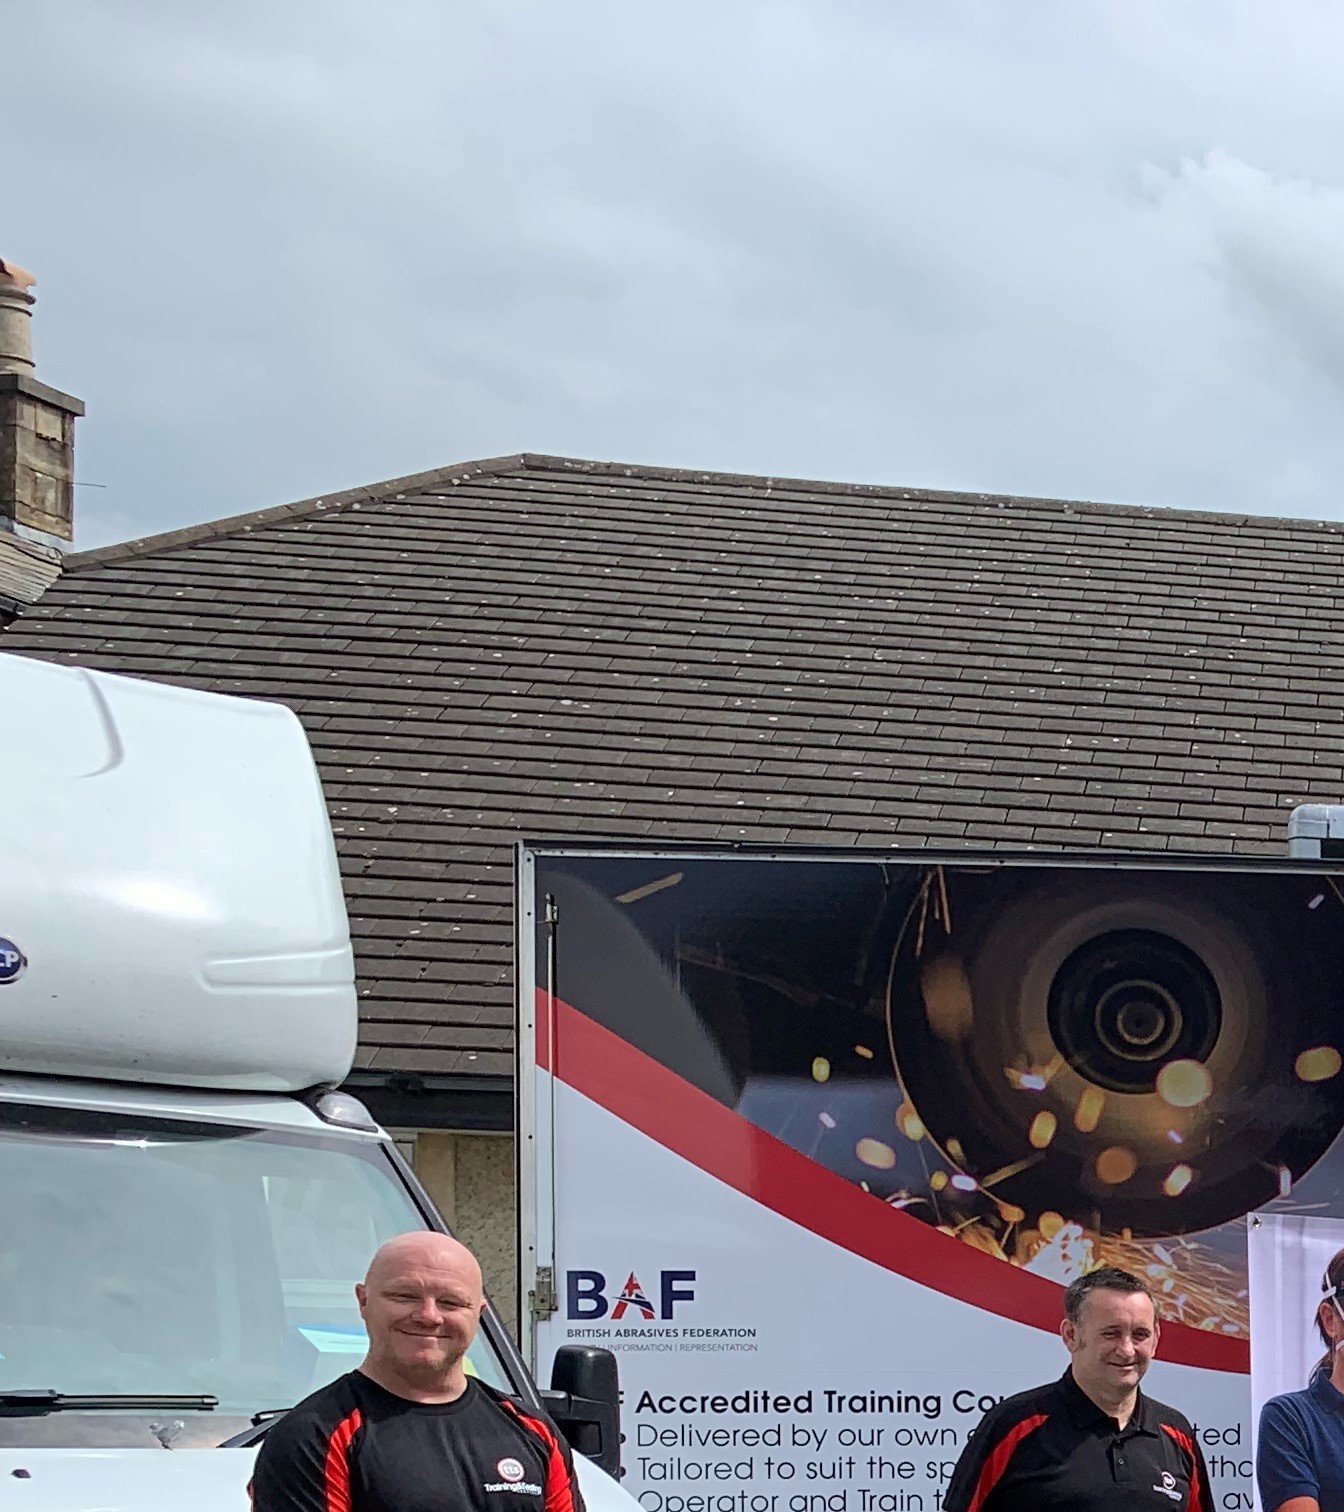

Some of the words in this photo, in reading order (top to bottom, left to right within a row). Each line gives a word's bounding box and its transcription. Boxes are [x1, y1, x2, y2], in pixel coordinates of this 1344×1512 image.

[567, 1270, 697, 1320] BAF
[567, 1328, 611, 1339] BRITISH
[614, 1328, 679, 1339] ABRASIVES
[682, 1328, 757, 1339] FEDERATION
[635, 1390, 813, 1414] Accredited
[823, 1390, 941, 1420] Training
[637, 1423, 781, 1447] Delivered
[792, 1423, 828, 1452] by
[838, 1428, 885, 1447] our
[894, 1428, 957, 1446] own
[637, 1456, 753, 1481] Tailored
[764, 1456, 796, 1480] to
[806, 1456, 856, 1480] suit
[866, 1456, 916, 1480] the
[788, 1489, 847, 1512] and
[857, 1488, 923, 1512] Train
